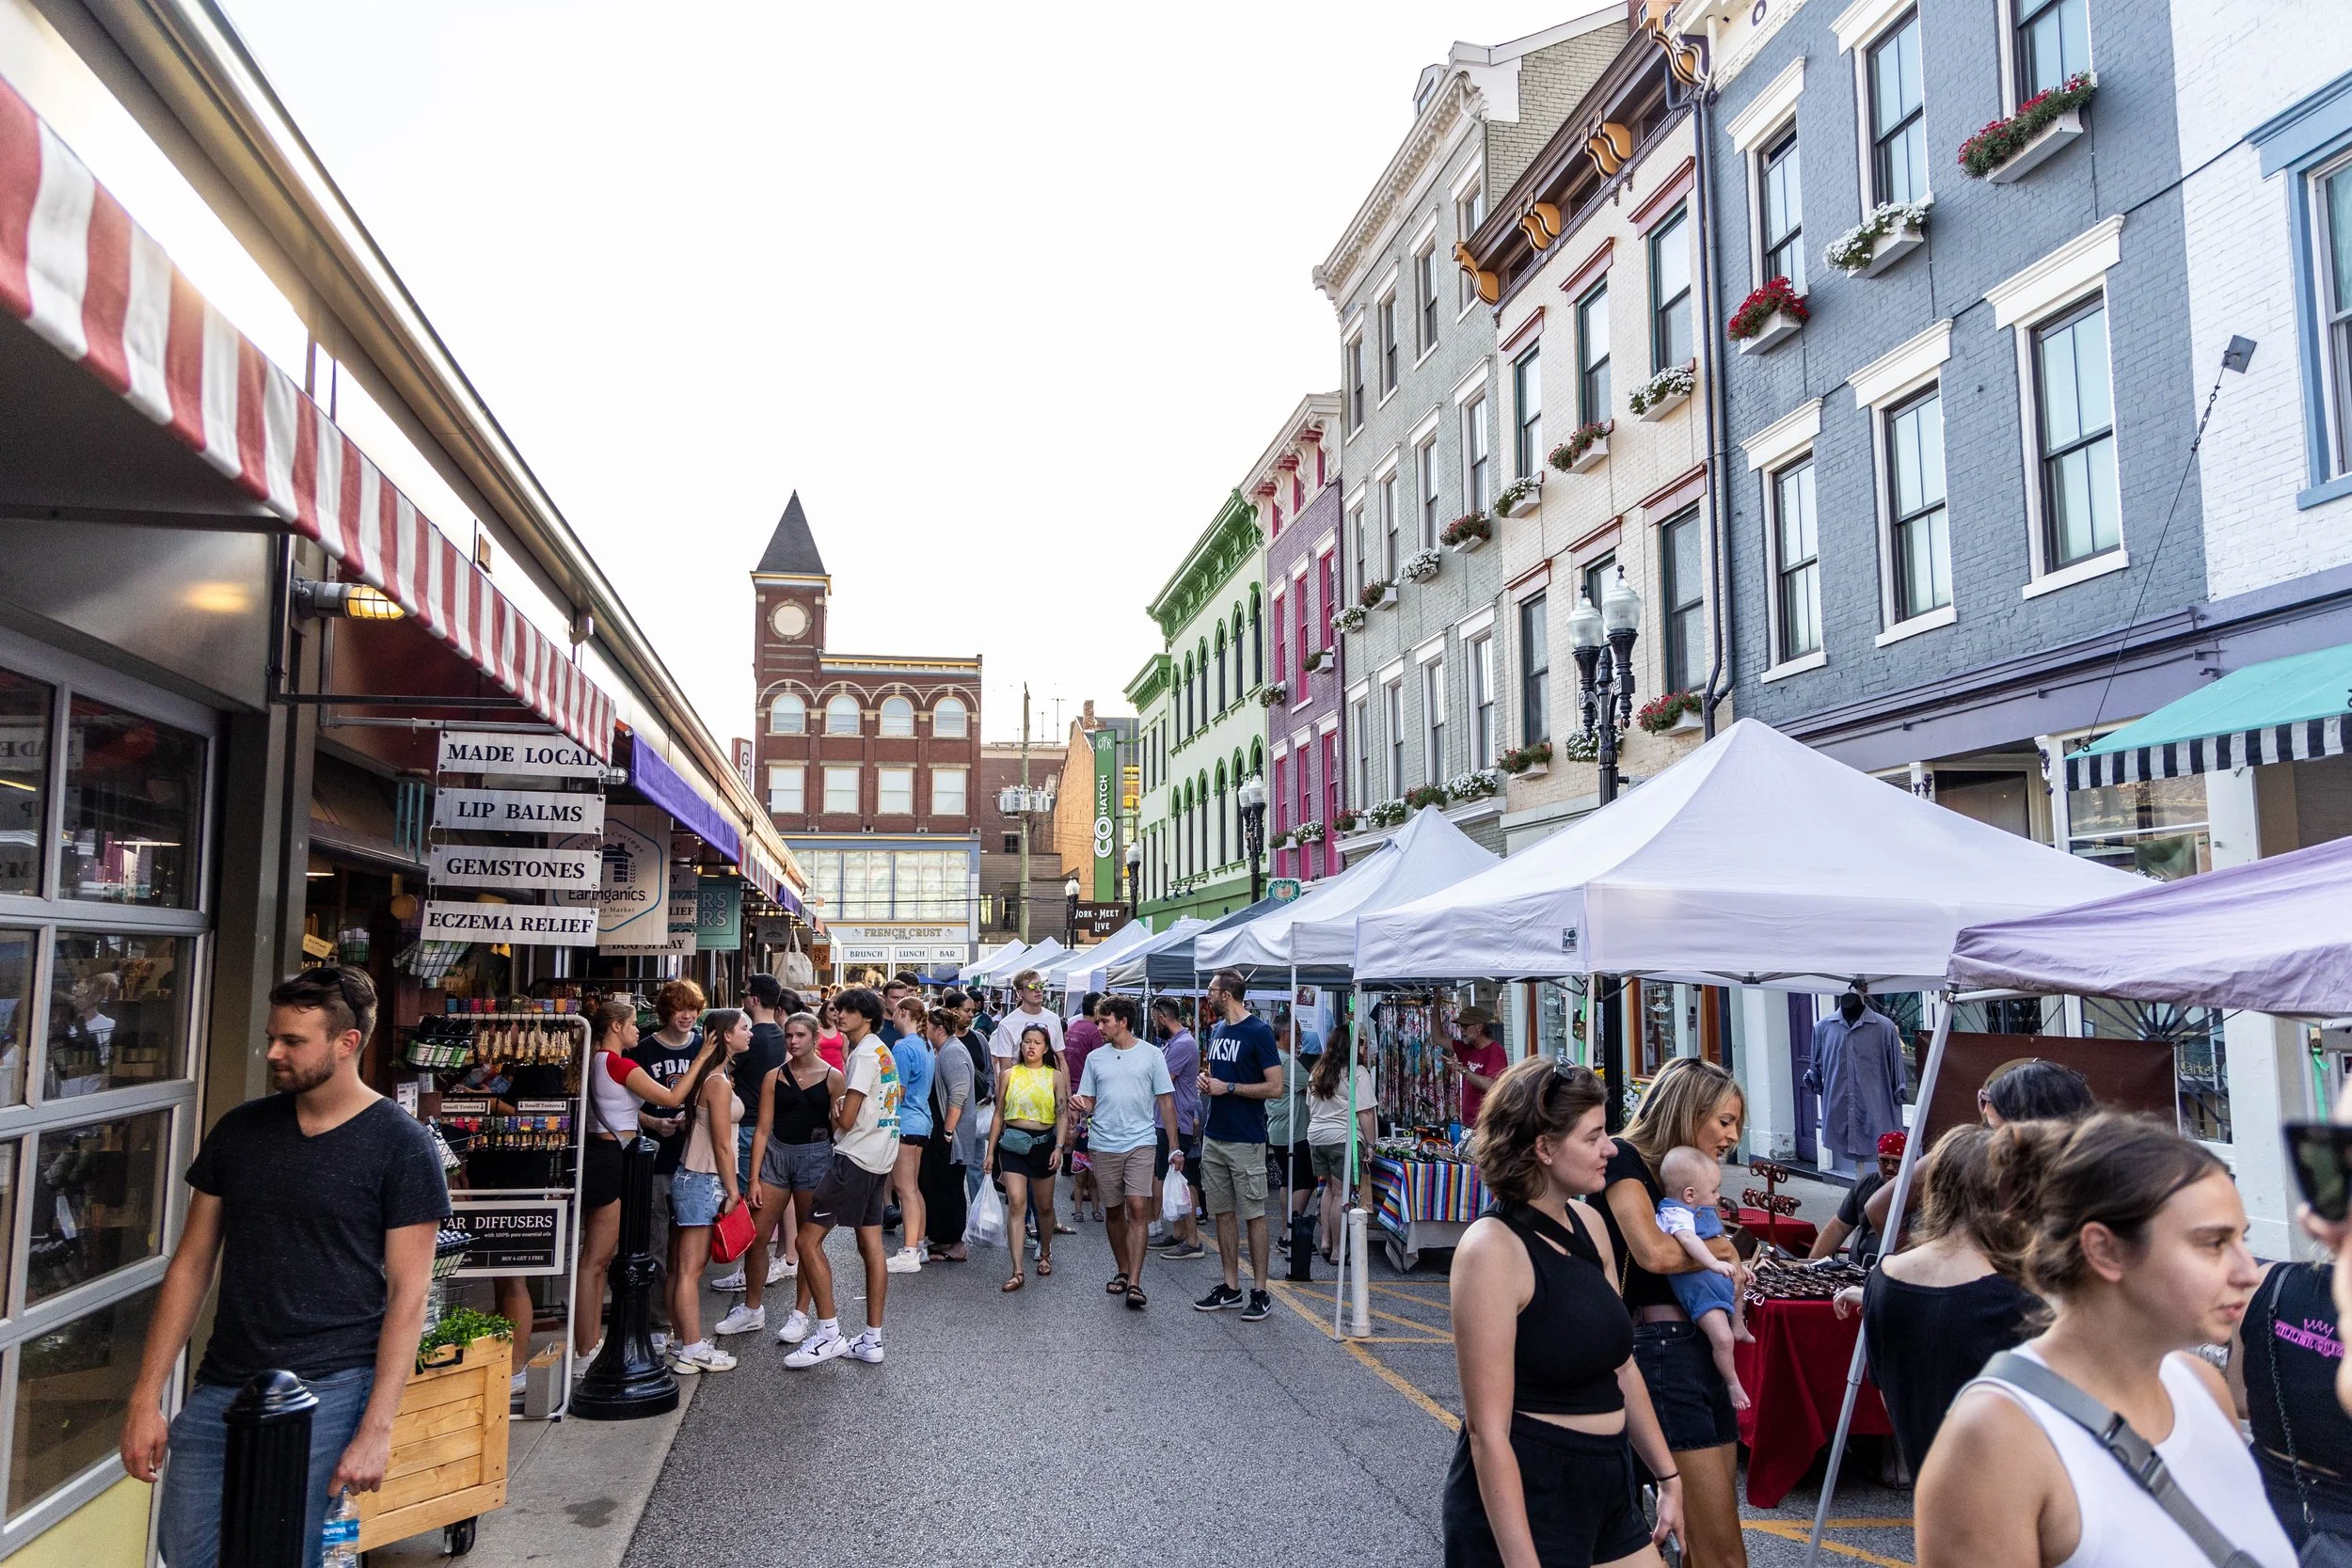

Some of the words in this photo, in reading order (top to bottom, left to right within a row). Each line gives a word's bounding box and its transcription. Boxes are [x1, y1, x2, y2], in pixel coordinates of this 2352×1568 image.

[447, 744, 514, 763] MADE
[525, 747, 597, 767] LOCAL
[457, 801, 495, 818] LIP
[505, 803, 582, 822] BALMS
[612, 831, 644, 853] Cottage
[447, 858, 585, 879] GEMSTONES
[669, 907, 694, 916] LIEF
[428, 912, 514, 931] ECZEMA
[519, 917, 593, 934] RELIEF
[864, 927, 907, 937] FRENCH
[909, 927, 943, 937] CRUST
[650, 1058, 691, 1079] FDN
[444, 1216, 467, 1229] AR
[474, 1215, 553, 1229] DIFFUSERS
[323, 1527, 346, 1536] QUAFINA
